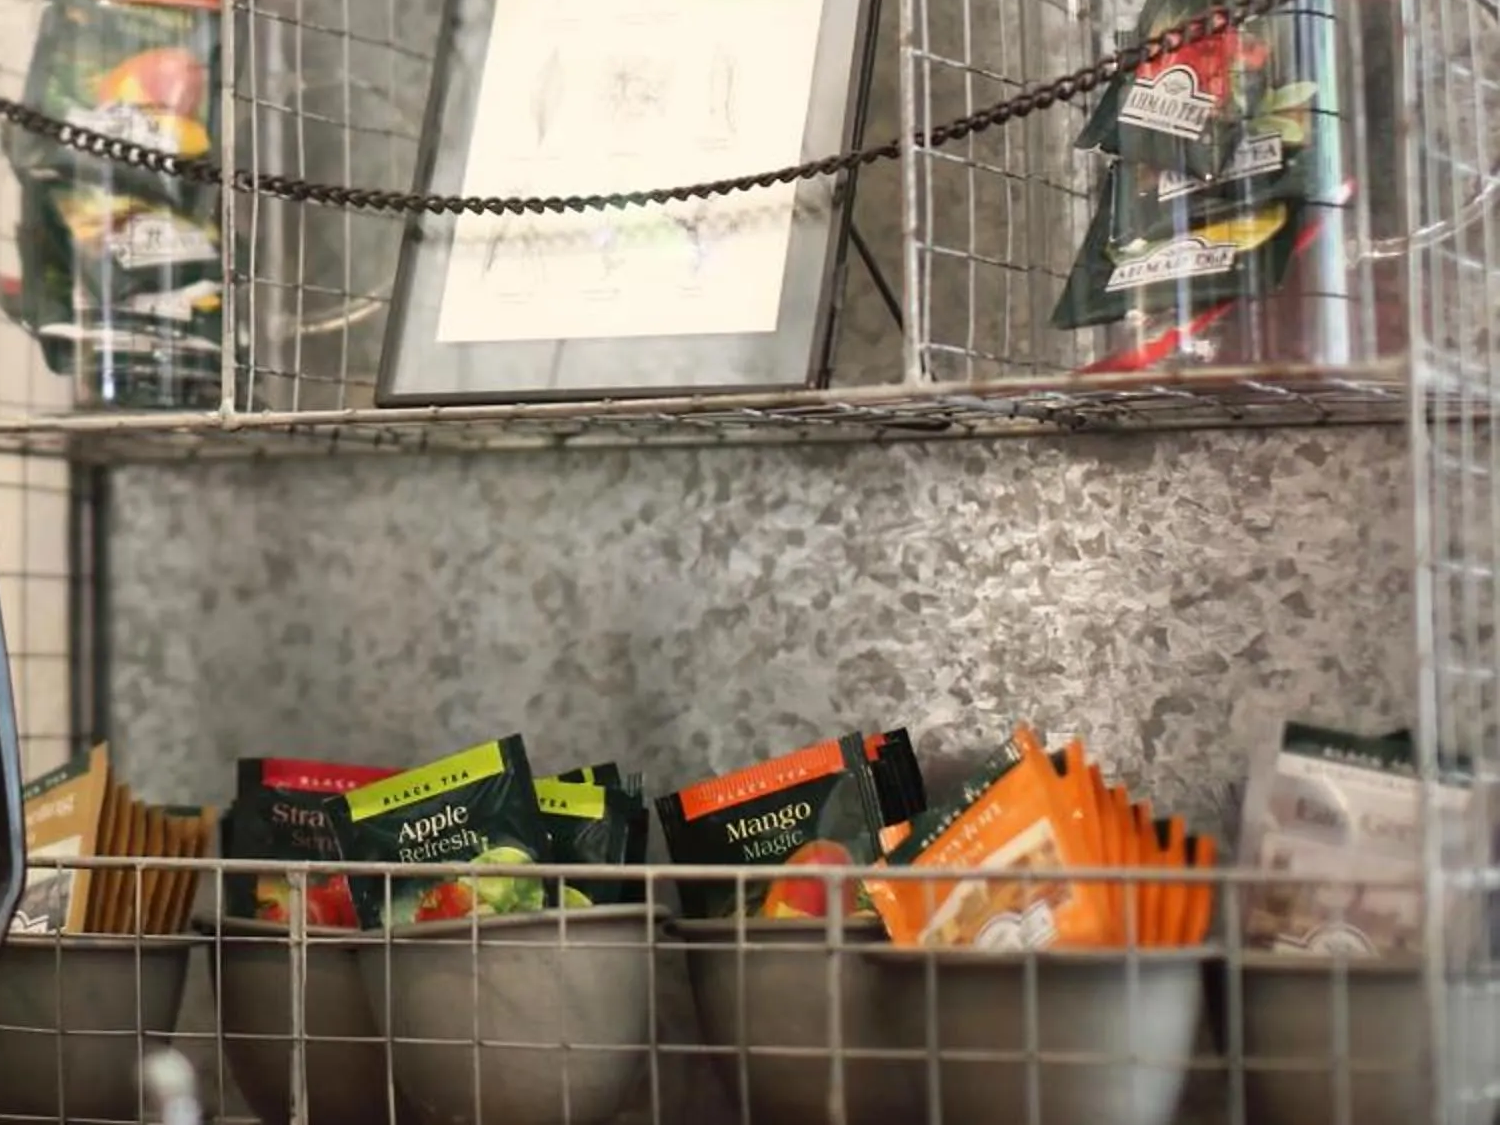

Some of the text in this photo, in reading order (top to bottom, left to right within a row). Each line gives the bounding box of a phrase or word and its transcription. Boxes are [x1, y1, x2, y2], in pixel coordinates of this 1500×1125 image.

[1130, 91, 1179, 117] AHMAD
[1177, 100, 1208, 127] TEA
[383, 770, 470, 806] BLACK TEA
[539, 796, 568, 810] TEA
[716, 767, 808, 804] BLACK TEA
[271, 801, 326, 829] Stra
[398, 804, 470, 843] Apple
[725, 801, 812, 844] Mango
[399, 826, 480, 863] Refresh
[742, 828, 805, 862] Magic
